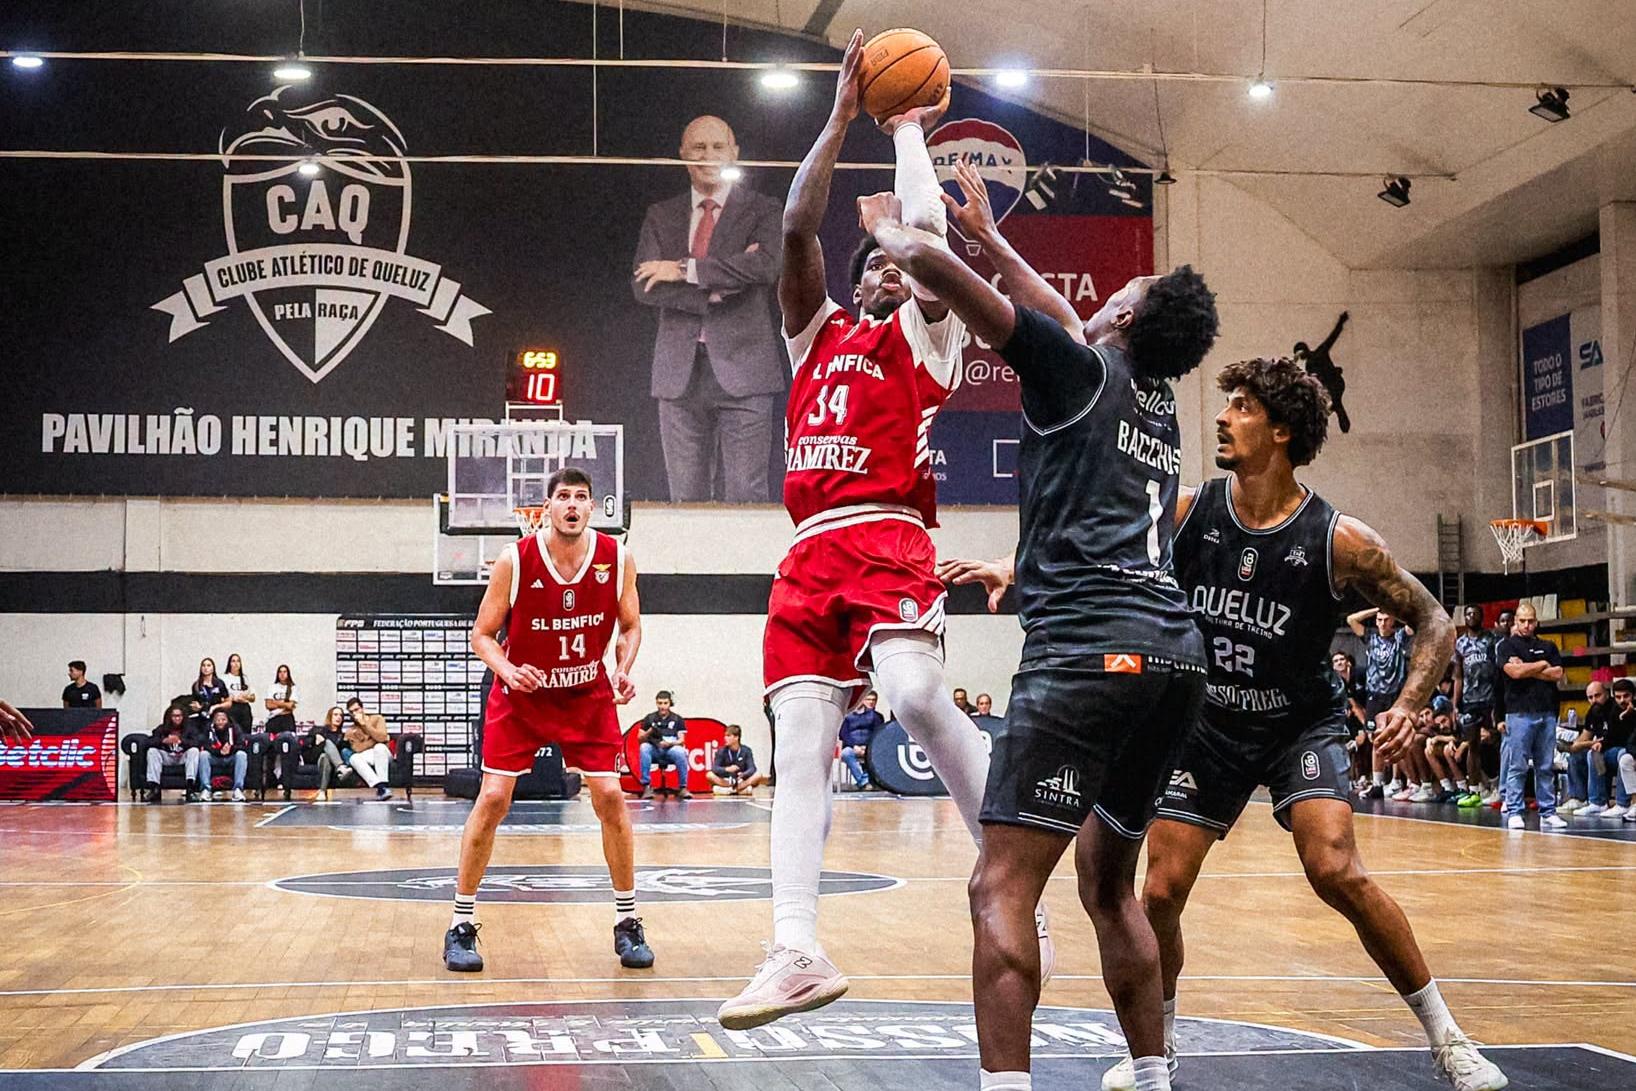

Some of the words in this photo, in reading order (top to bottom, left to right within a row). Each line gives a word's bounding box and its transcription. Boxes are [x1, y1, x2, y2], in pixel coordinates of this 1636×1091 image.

[265, 180, 370, 245] CAQ
[217, 259, 267, 288] CLUBE
[272, 250, 343, 277] ATLÉTICO
[348, 256, 369, 278] DE
[372, 259, 431, 292] QUELUZ
[274, 302, 312, 320] PELA
[317, 303, 359, 322] RAÇA
[527, 373, 555, 401] 10
[1534, 374, 1551, 392] TIPO
[1552, 370, 1563, 387] DE
[1532, 389, 1566, 411] ESTORES
[41, 407, 221, 455] PAVILHÃO
[232, 416, 415, 462] HENRIQUE
[1145, 479, 1163, 567] 1
[531, 618, 549, 630] SL
[1192, 585, 1291, 636] QUELUZ
[1234, 622, 1244, 630] DE
[559, 633, 586, 661] 14
[1213, 637, 1255, 679] 22
[1034, 788, 1081, 807] SINTRA
